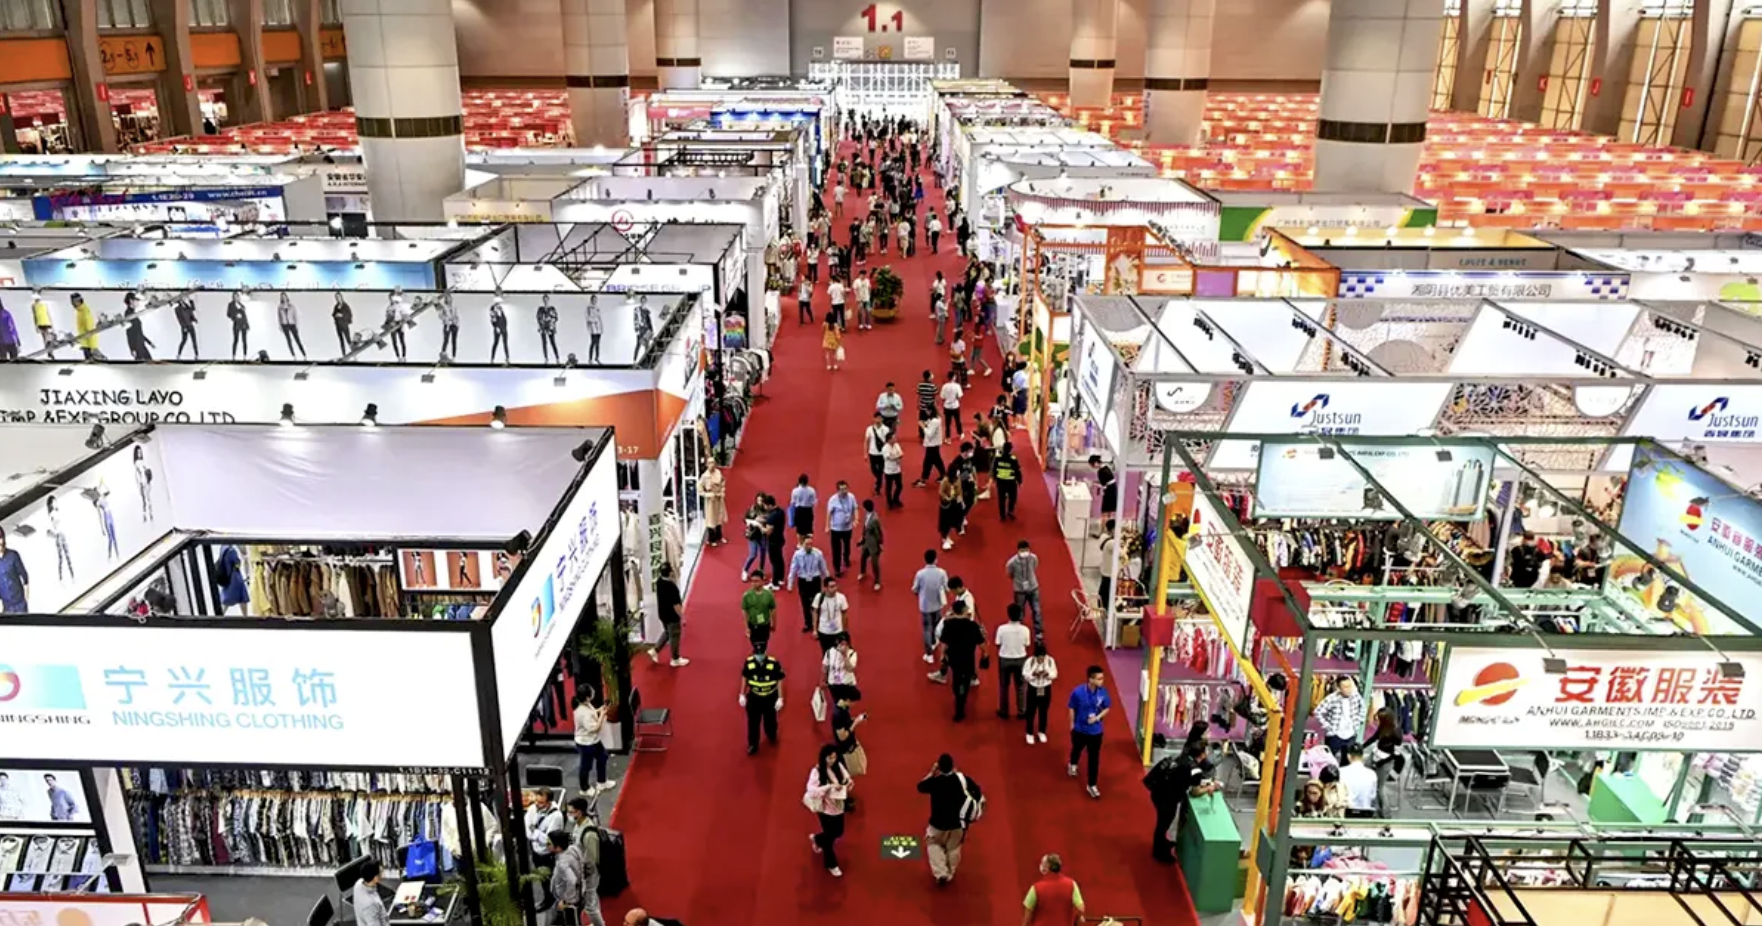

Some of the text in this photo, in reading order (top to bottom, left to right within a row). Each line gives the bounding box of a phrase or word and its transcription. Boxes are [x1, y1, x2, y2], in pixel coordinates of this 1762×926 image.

[861, 4, 903, 32] 1.1
[40, 390, 184, 406] JIAXING LAYO
[1309, 410, 1362, 426] Justsun
[1706, 413, 1759, 428] Justsun
[104, 665, 338, 708] 宁兴服饰
[1554, 665, 1743, 705] 安徽服装
[112, 710, 344, 730] NINGSHING CLOTHING
[1526, 706, 1568, 716] ANHUI
